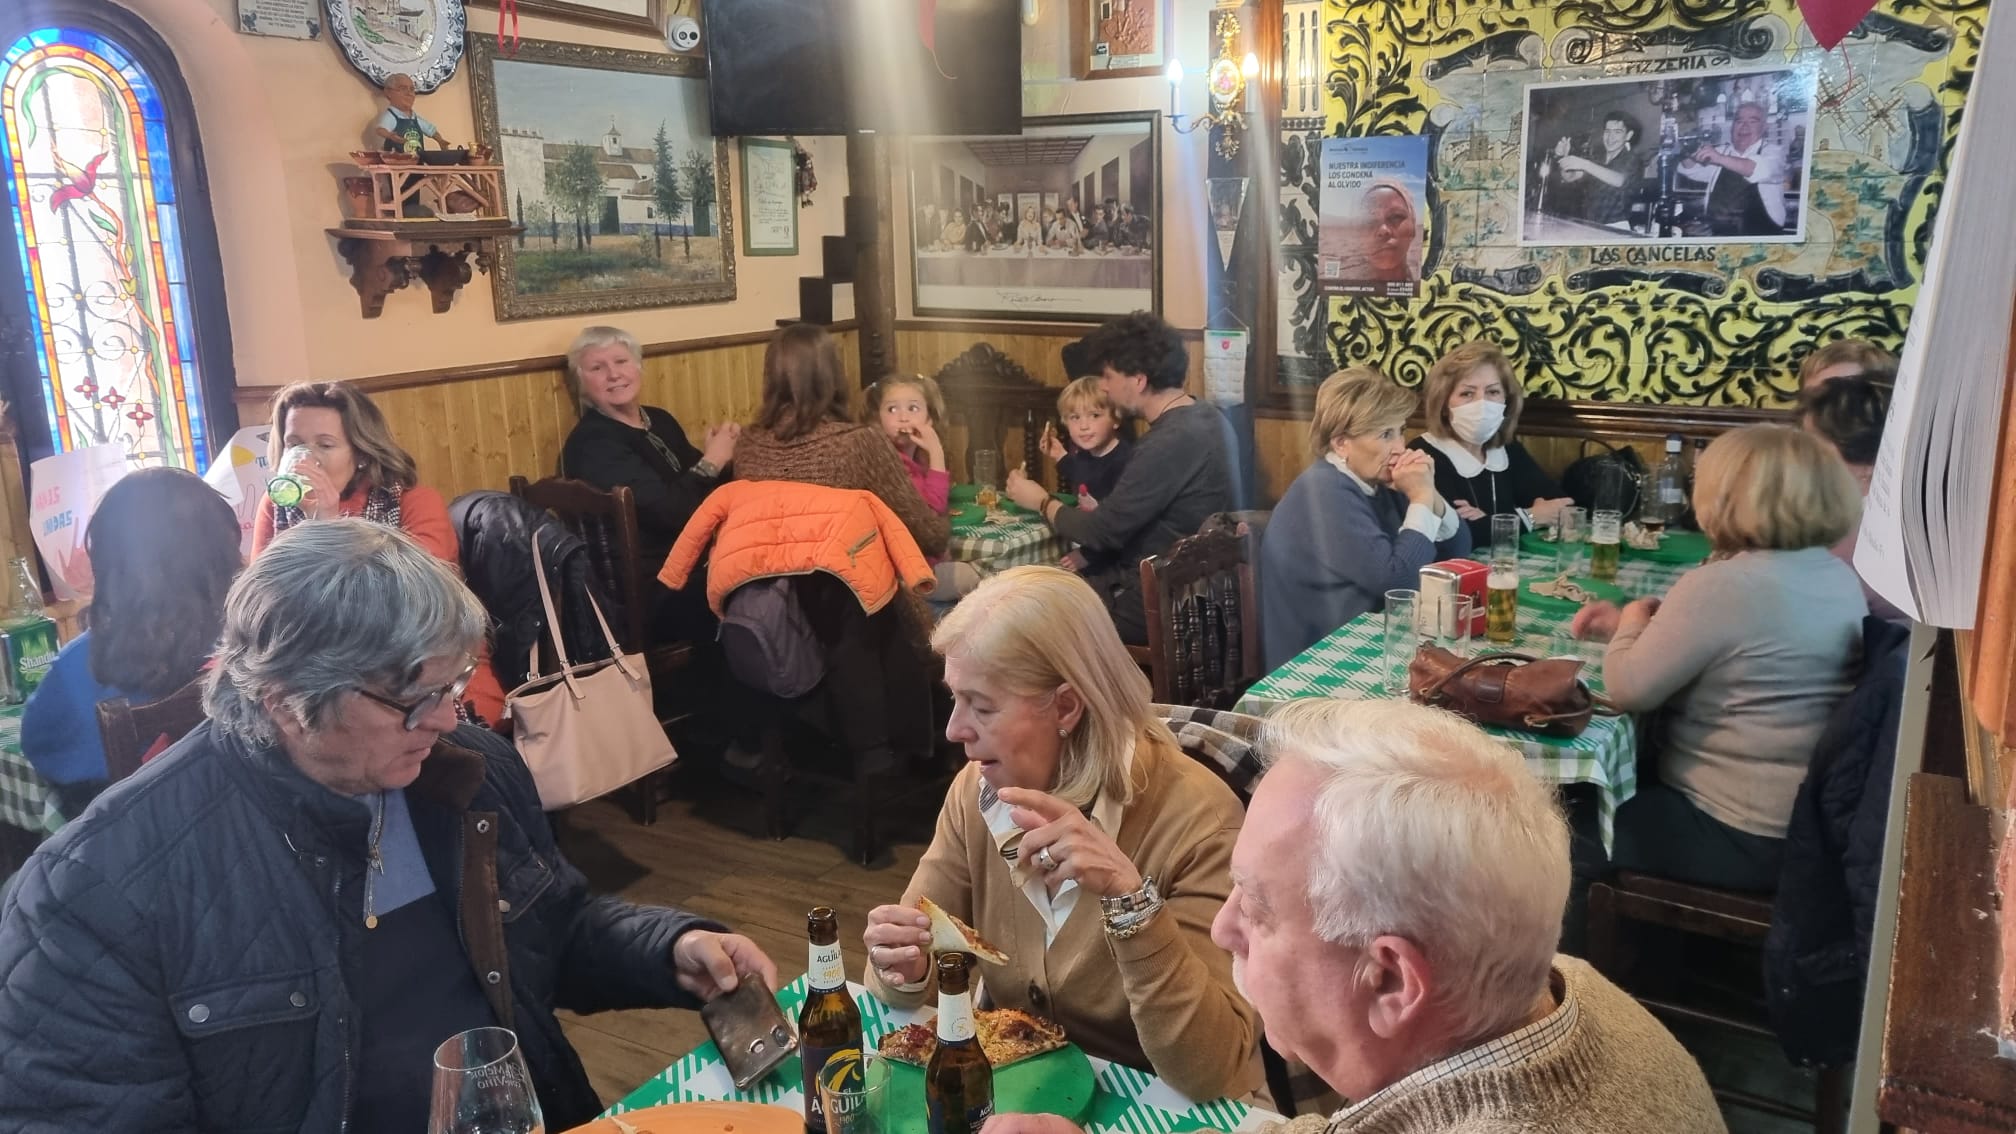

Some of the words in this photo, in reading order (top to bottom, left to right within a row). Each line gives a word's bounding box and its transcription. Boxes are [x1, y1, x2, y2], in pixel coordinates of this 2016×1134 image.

[1626, 55, 1707, 74] PIZZERIA
[1328, 161, 1359, 170] NUESTRA
[1360, 160, 1405, 169] INDIFERENCIA
[1328, 171, 1341, 179] LOS
[1342, 170, 1373, 178] CONDENA
[1328, 181, 1336, 189] AL
[1337, 180, 1361, 188] OLVIDO
[1591, 247, 1620, 265] LAS
[1626, 246, 1716, 265] CANCELAS
